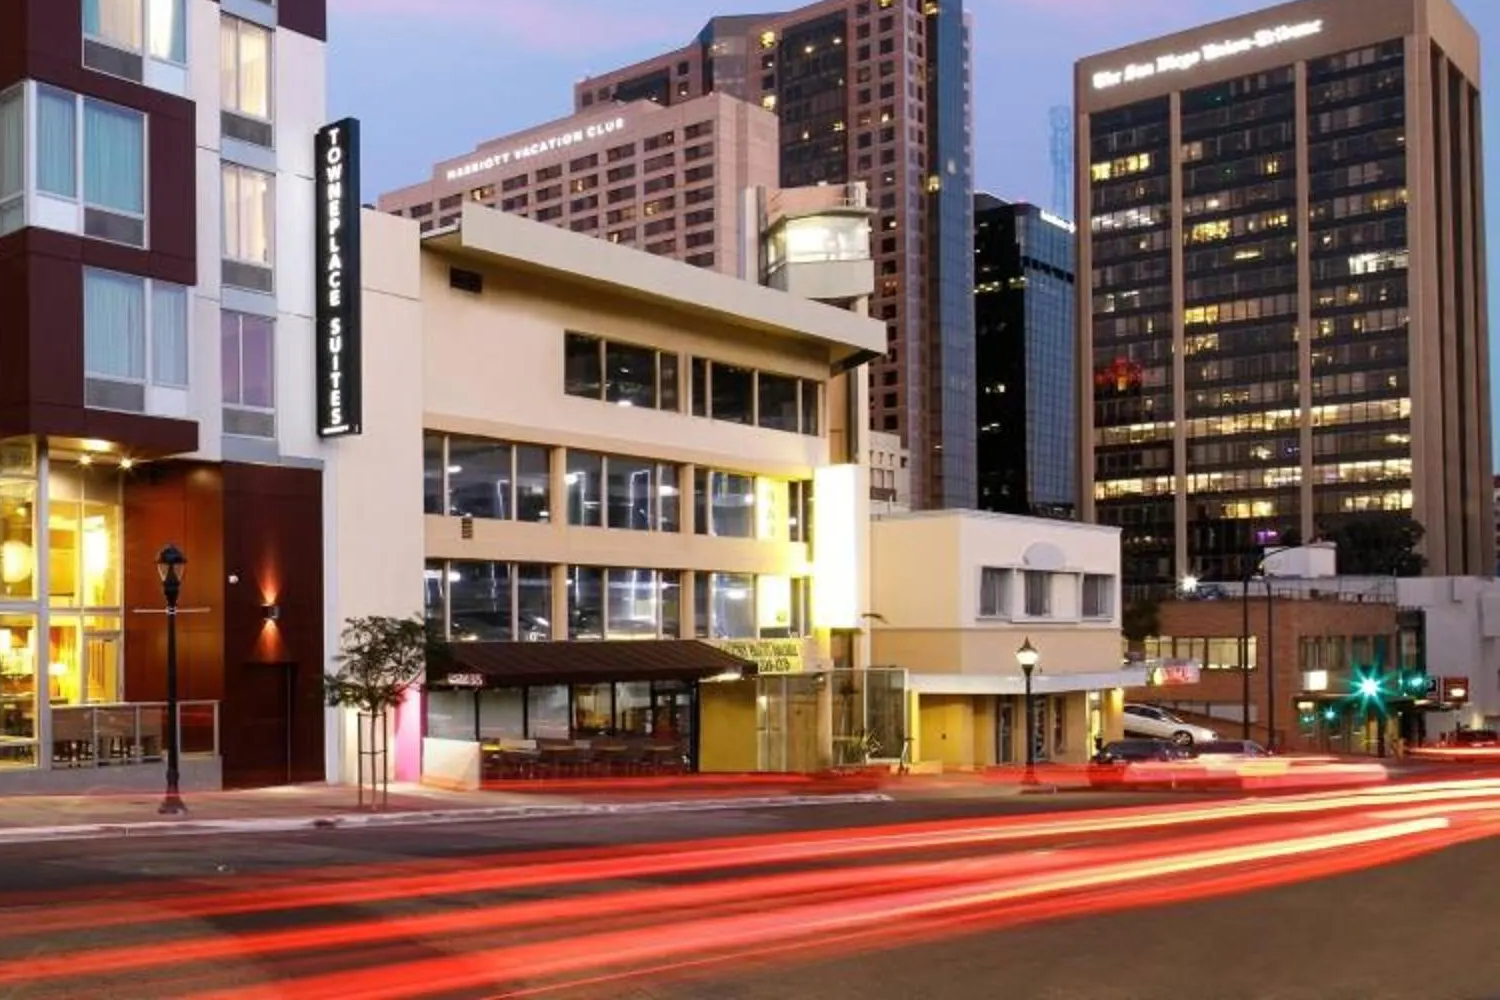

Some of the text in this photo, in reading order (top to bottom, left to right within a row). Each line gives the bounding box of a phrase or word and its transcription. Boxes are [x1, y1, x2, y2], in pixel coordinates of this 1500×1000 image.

[446, 117, 625, 182] MARRIOTT VACATION CLUB
[327, 127, 343, 307] TOWNEPLACE
[328, 317, 343, 425] SUITES
